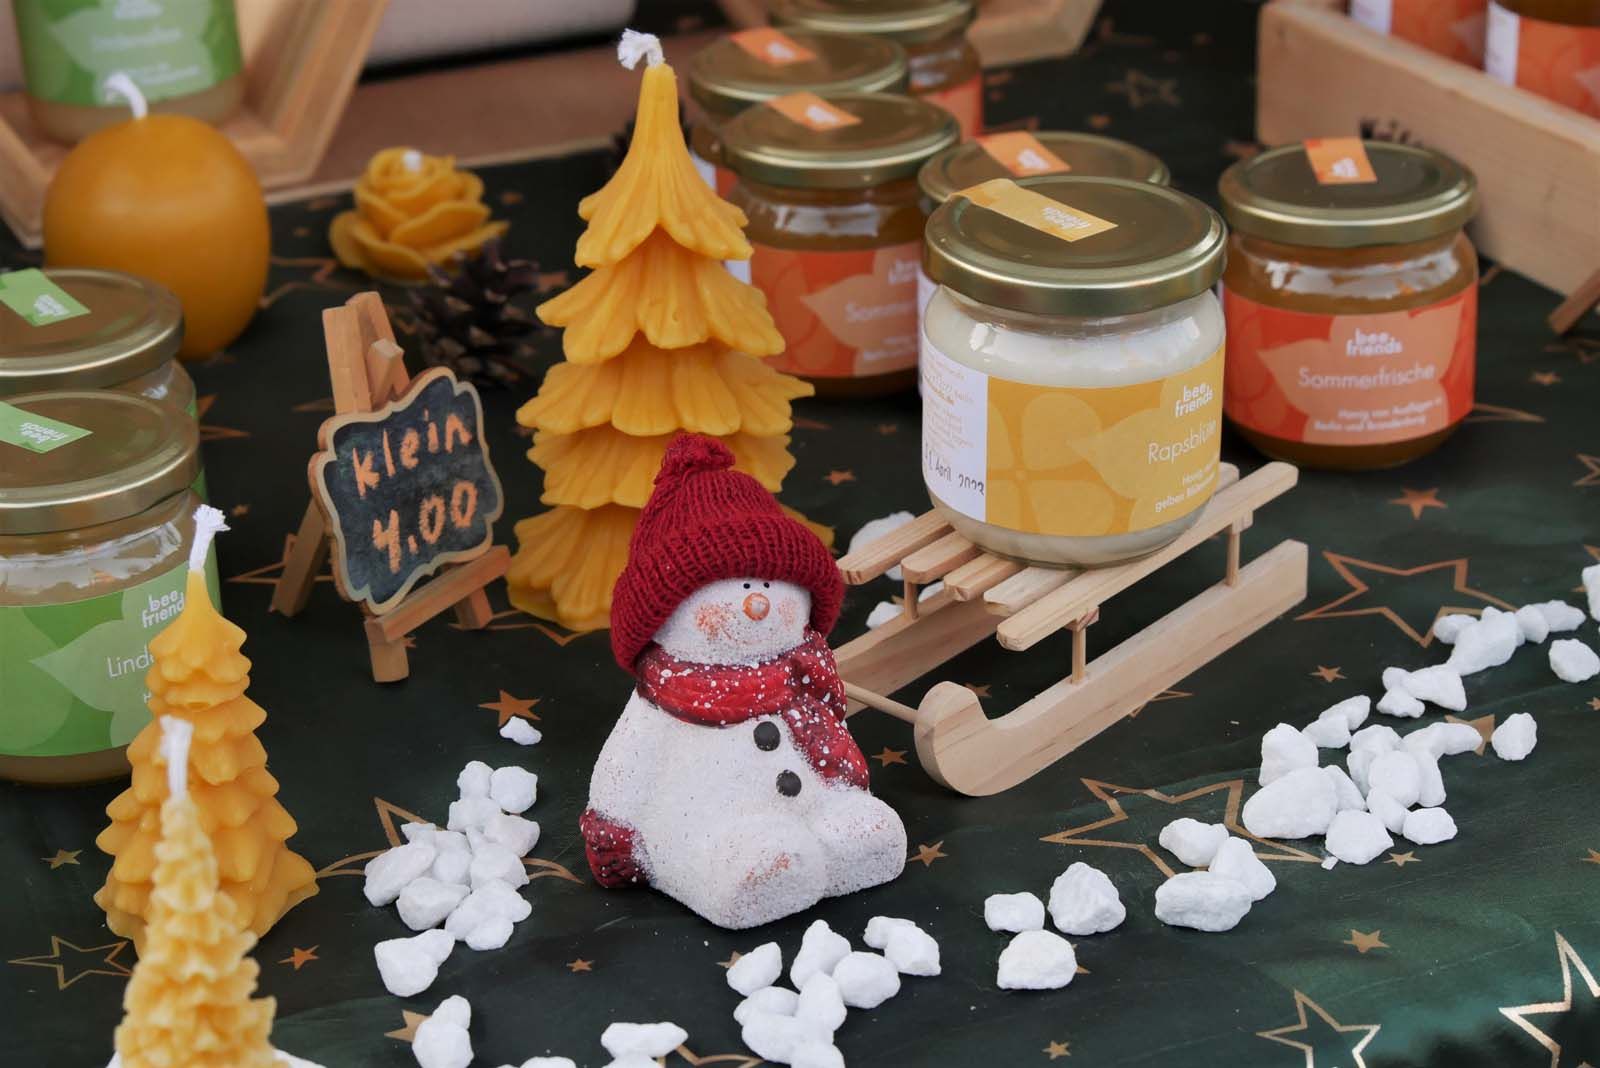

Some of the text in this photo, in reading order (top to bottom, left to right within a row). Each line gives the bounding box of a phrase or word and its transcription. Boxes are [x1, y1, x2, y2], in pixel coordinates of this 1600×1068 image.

[142, 592, 186, 629] friend
[148, 590, 178, 612] bee
[107, 642, 154, 679] Lind
